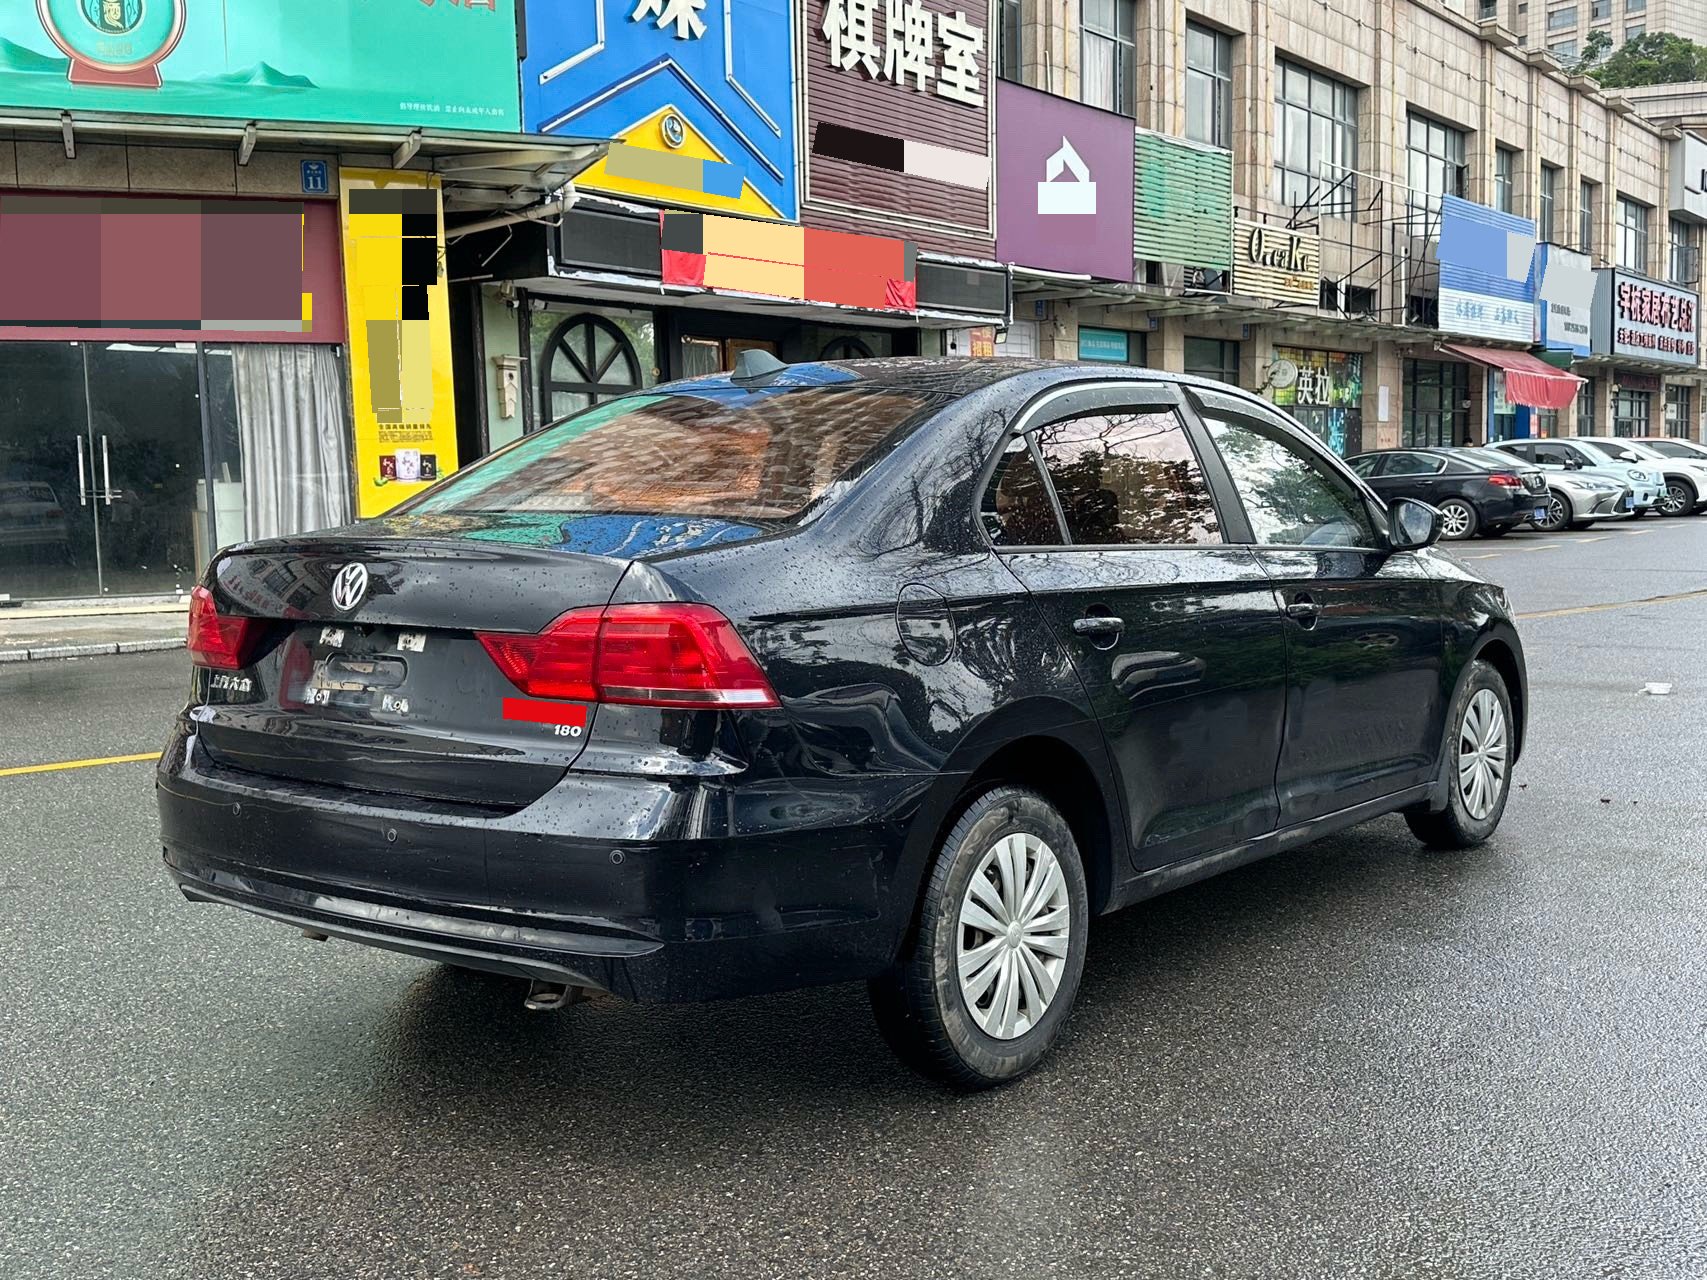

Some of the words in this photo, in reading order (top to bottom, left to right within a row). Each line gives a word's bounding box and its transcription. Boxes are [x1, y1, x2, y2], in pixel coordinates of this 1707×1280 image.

[822, 0, 984, 107] 棋牌室
[307, 176, 324, 190] 11
[554, 724, 582, 738] 180
